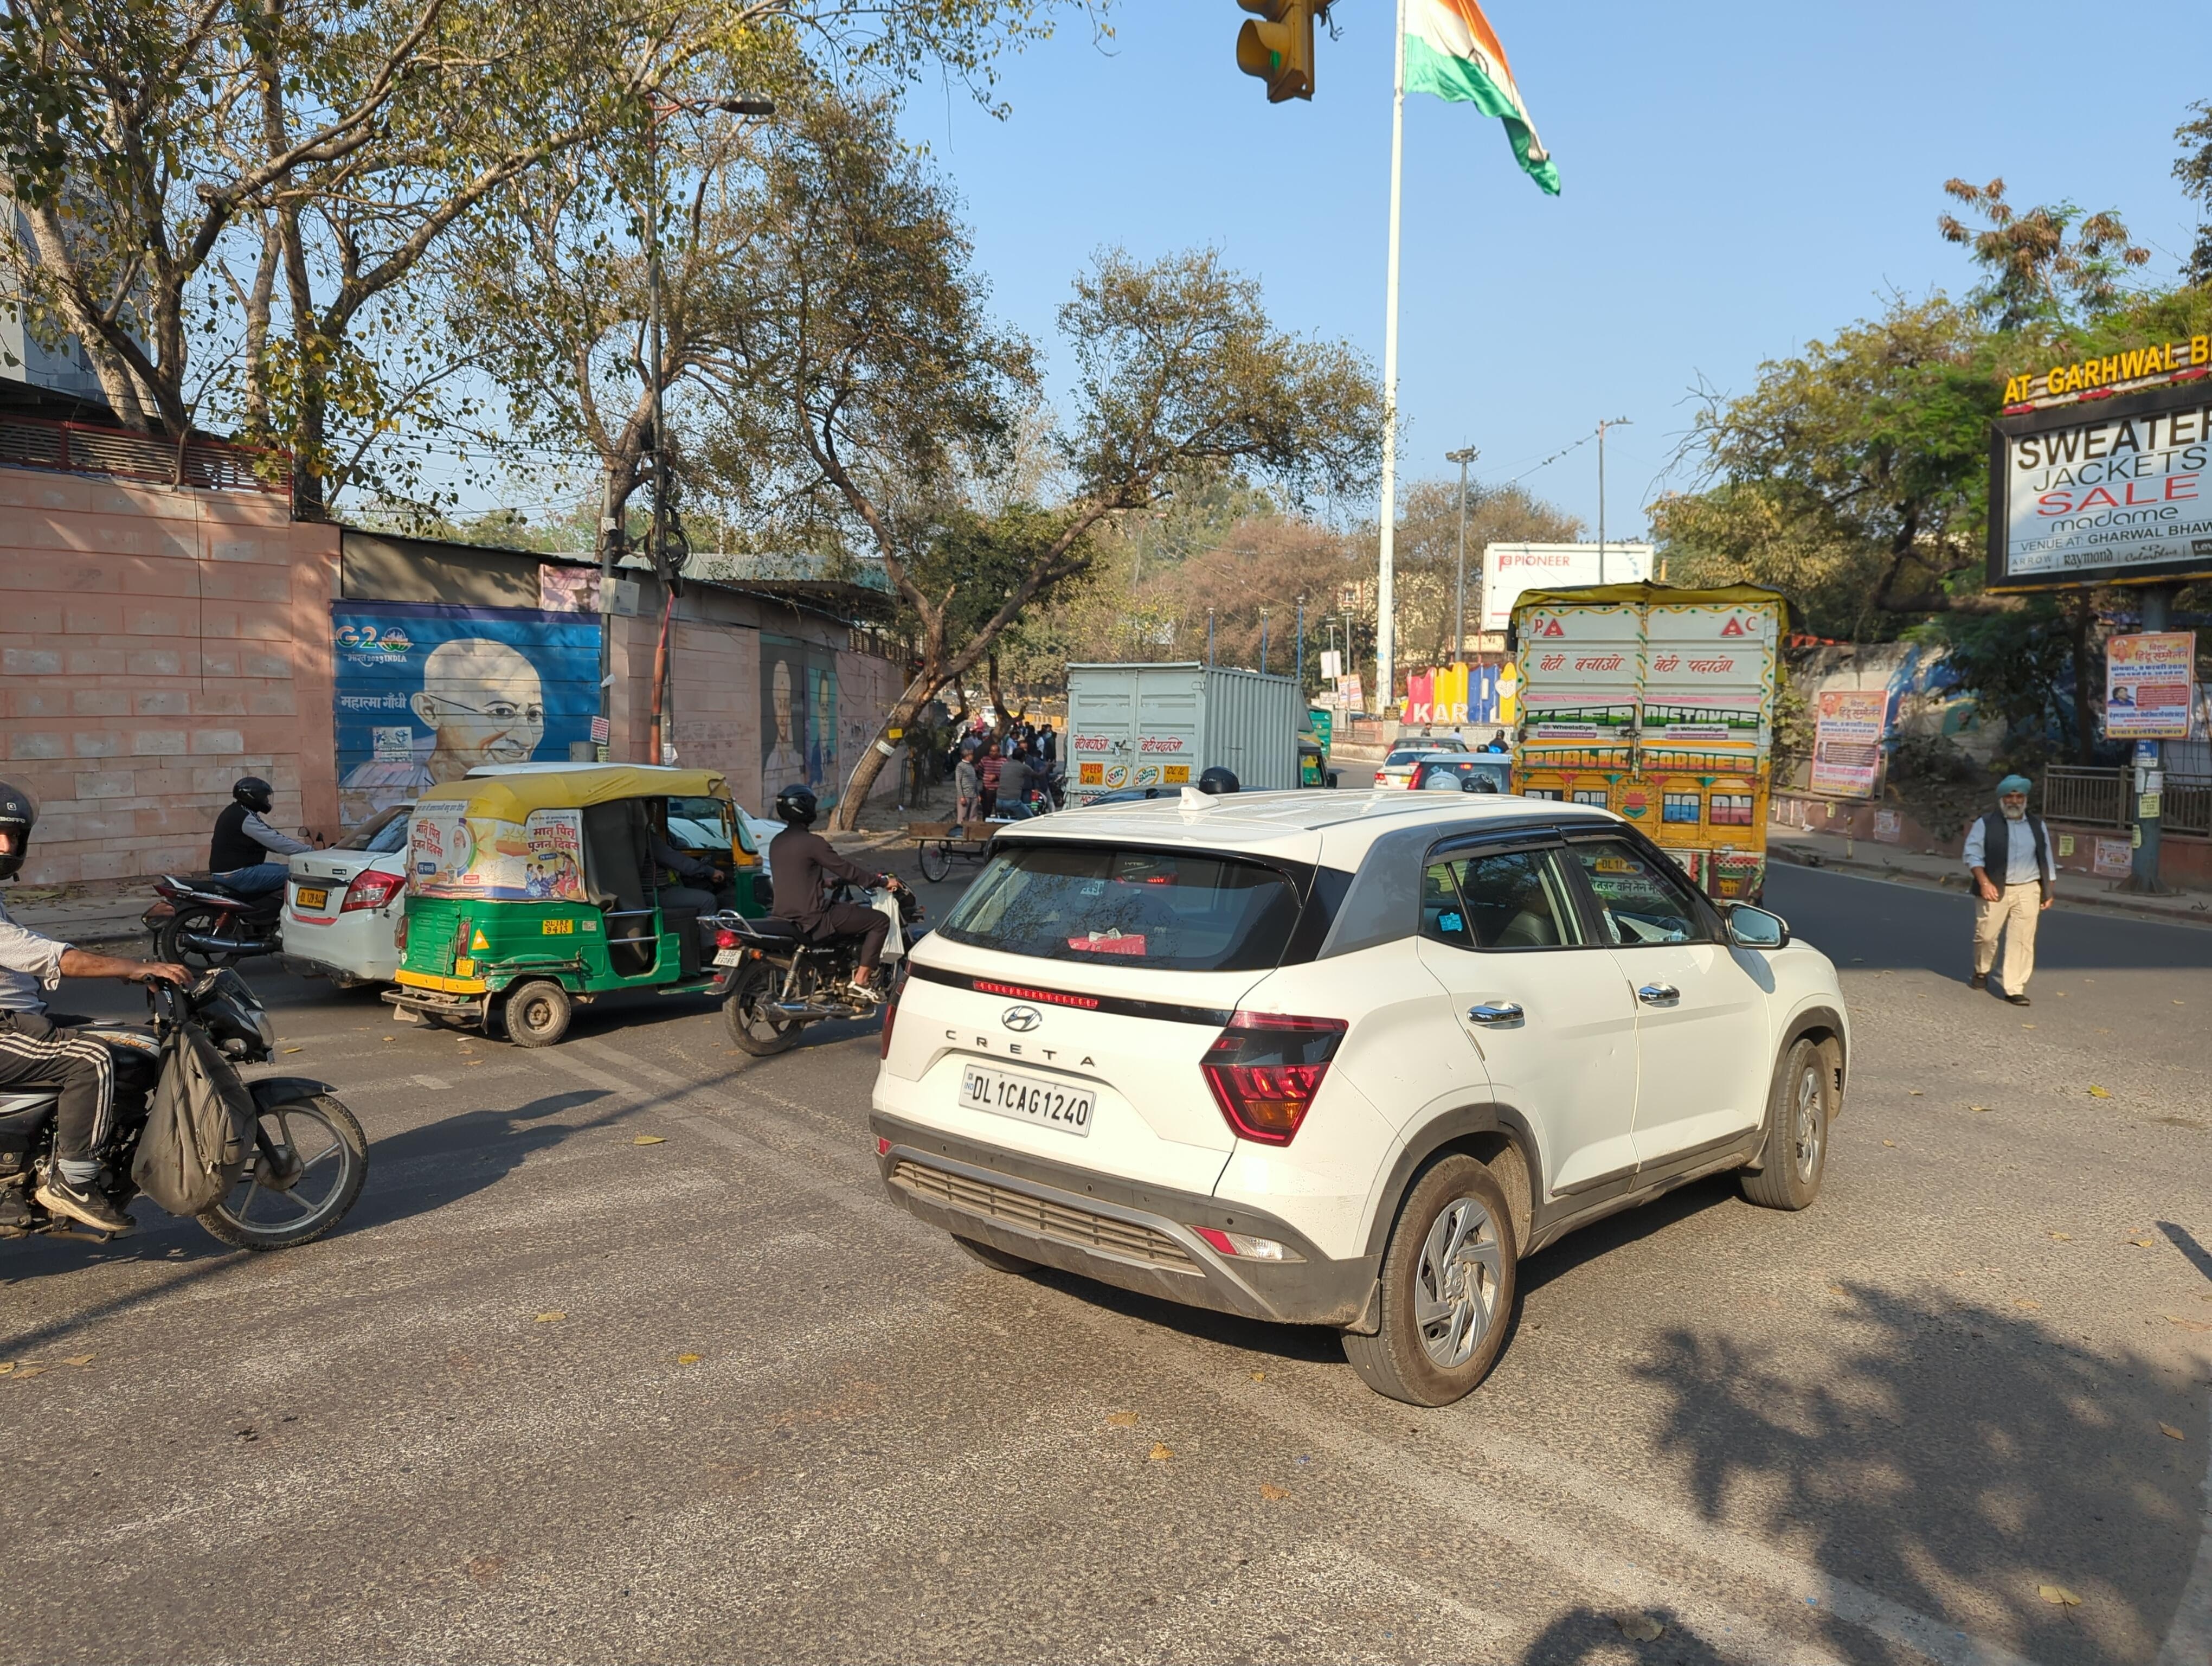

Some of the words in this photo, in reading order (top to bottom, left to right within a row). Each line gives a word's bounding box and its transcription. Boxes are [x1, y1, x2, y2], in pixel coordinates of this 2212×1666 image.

[2003, 374, 2031, 405] AT
[2047, 342, 2180, 394] GARHWAL
[2191, 335, 2212, 365] B
[2033, 446, 2207, 492] JACKETS
[2037, 473, 2200, 516] SALE
[2052, 507, 2178, 532] madame
[2021, 538, 2063, 551] VENUE
[2088, 527, 2164, 544] GHARWAL
[1514, 556, 1570, 566] PIONEER
[2012, 555, 2052, 566] ARROW
[2064, 548, 2113, 568] Raymond
[1540, 654, 1566, 671] बेटी
[1575, 653, 1625, 671] बचाओ
[1654, 655, 1681, 672] बेटी
[341, 696, 381, 711] महात्मा
[1527, 707, 1634, 725] KEEP
[1644, 705, 1758, 728] DISTANCE
[946, 1029, 1097, 1068] CRETA
[964, 1082, 974, 1091] IND
[972, 1076, 1089, 1126] DL1CAG1240
